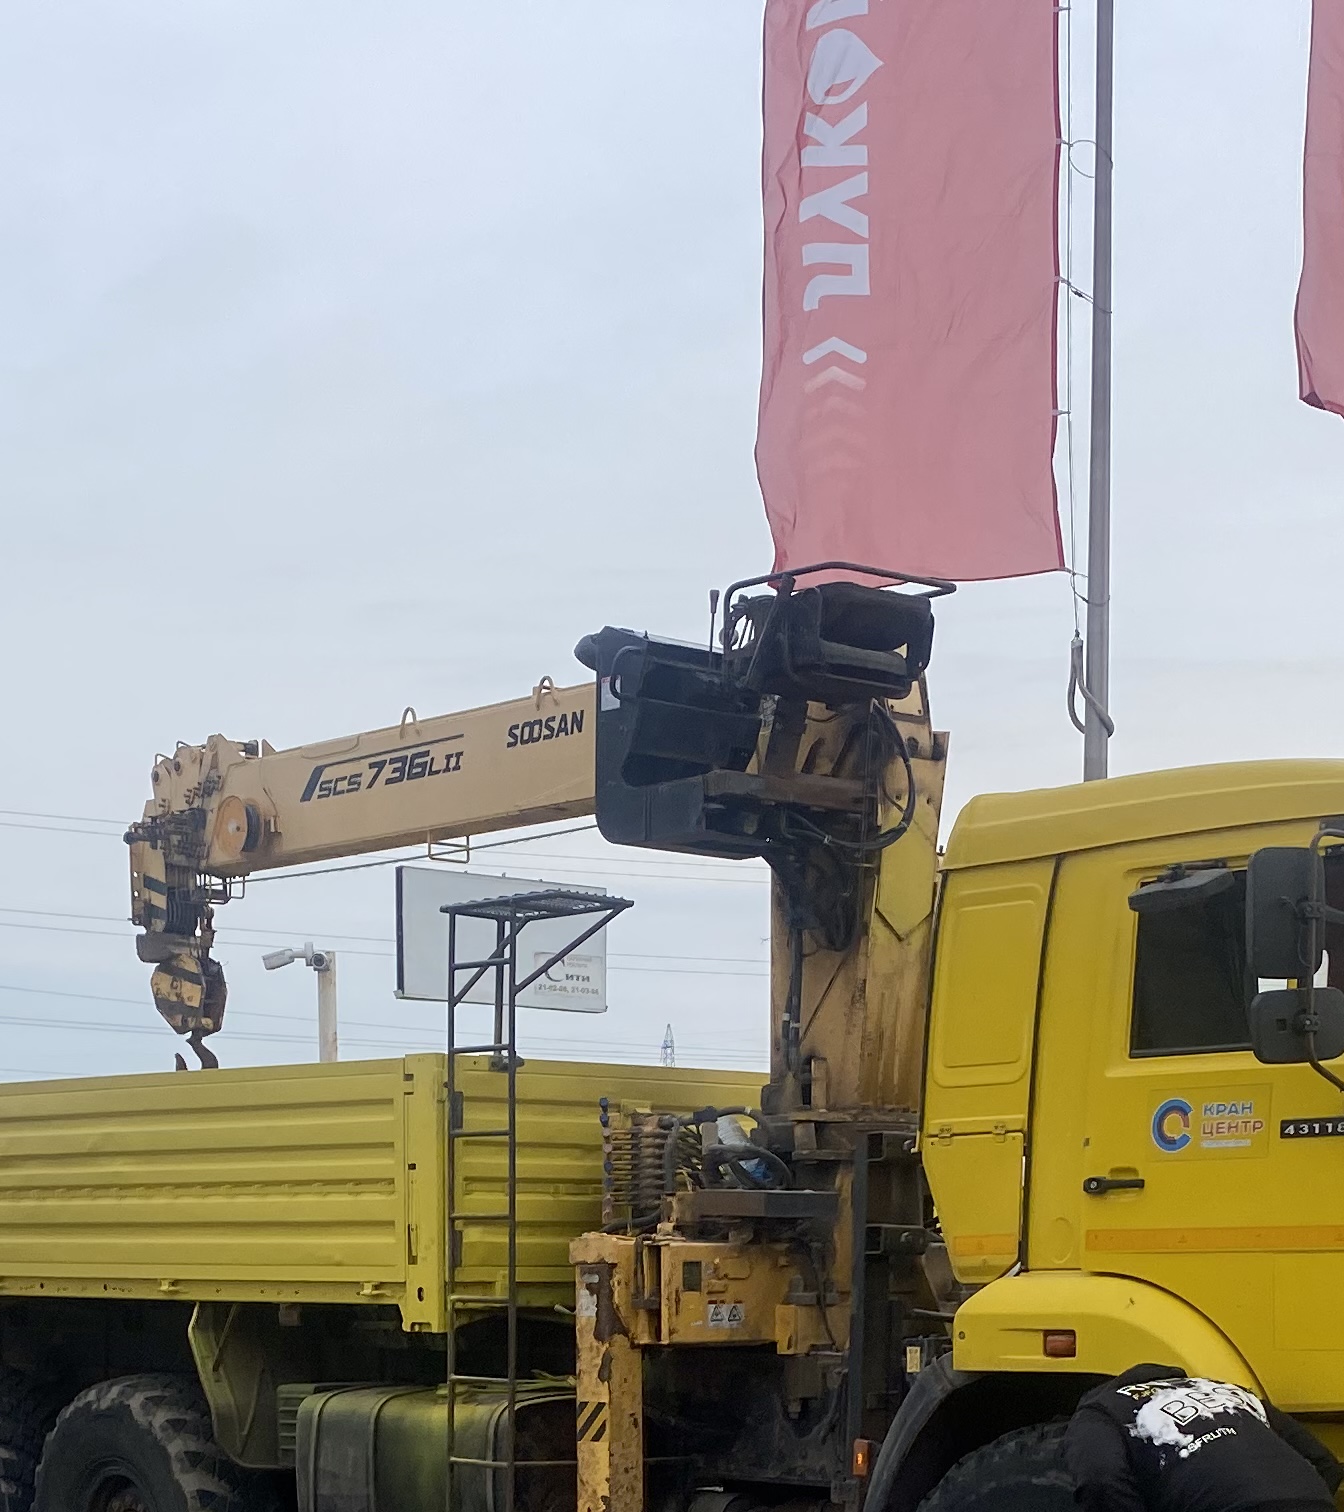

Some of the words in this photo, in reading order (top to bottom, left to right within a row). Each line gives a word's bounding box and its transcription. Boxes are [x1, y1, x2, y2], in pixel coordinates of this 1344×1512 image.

[507, 710, 585, 748] SOOSAN
[1203, 1101, 1253, 1117] КРАН
[1201, 1120, 1264, 1137] ЦЕНТР
